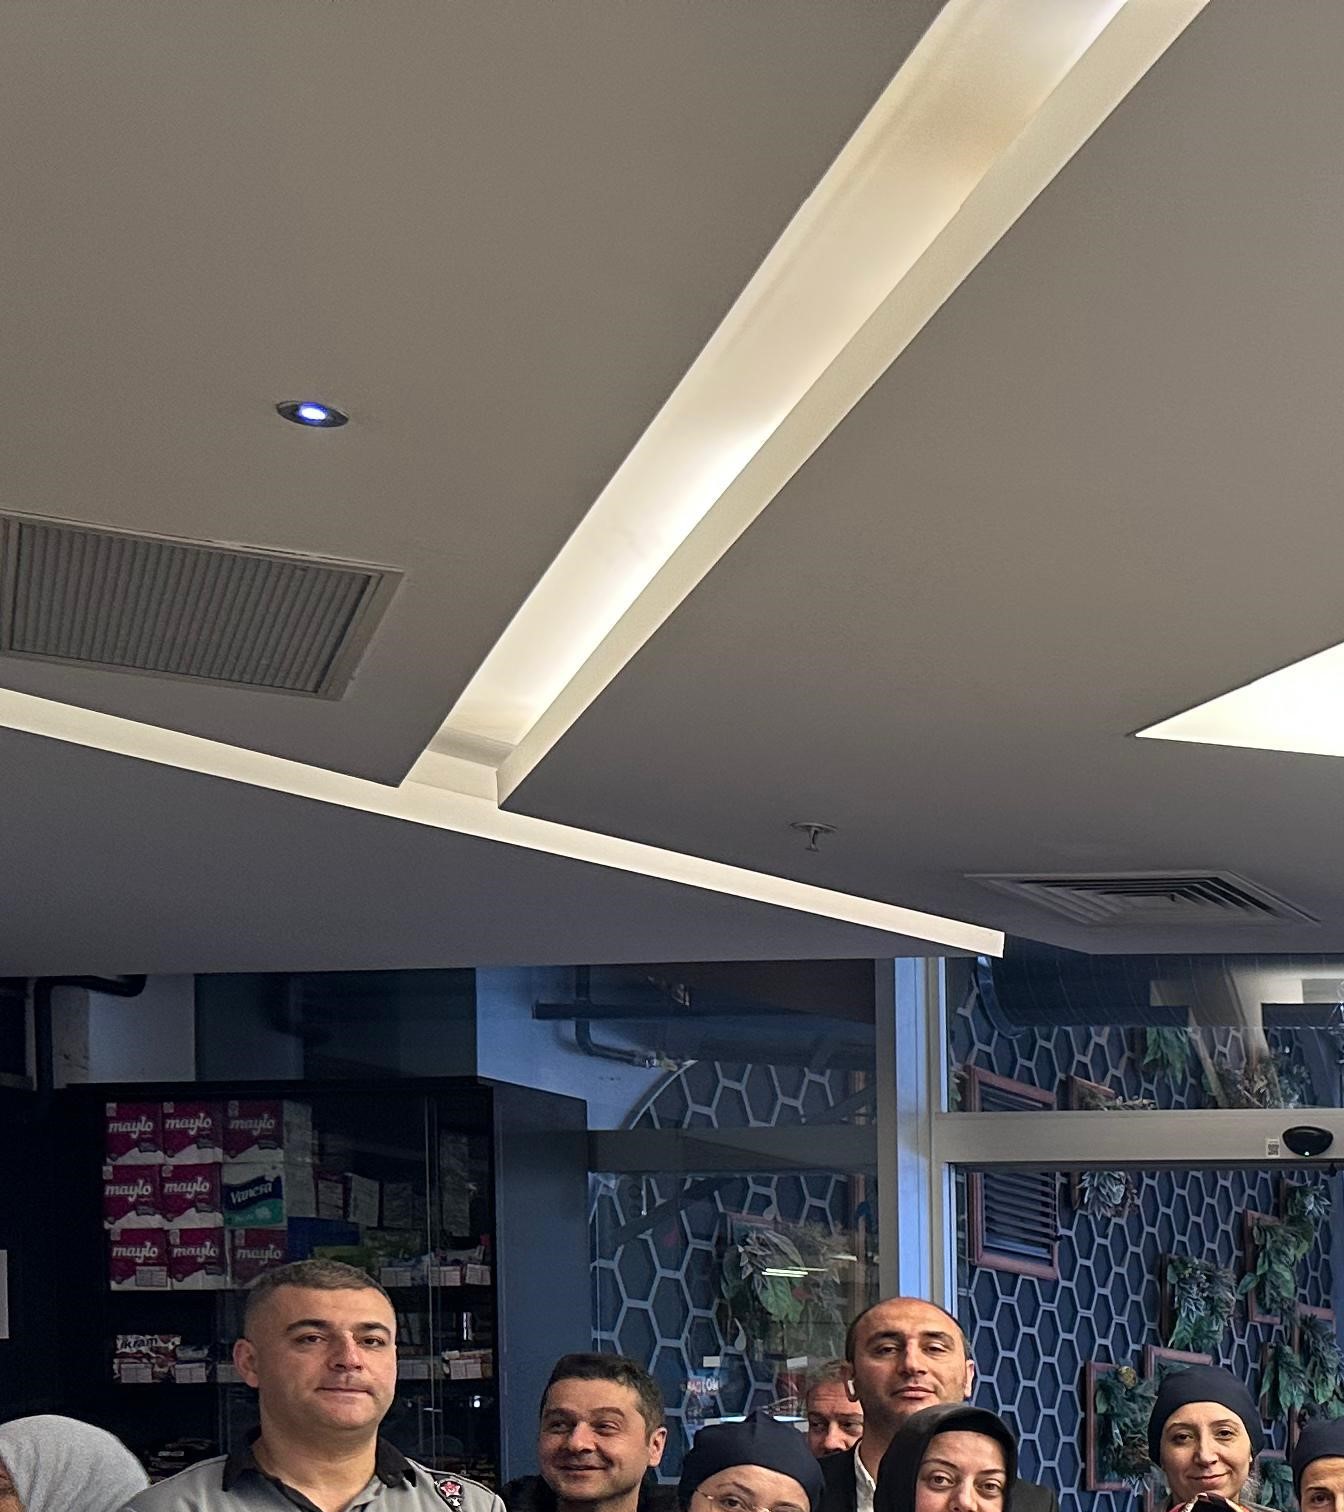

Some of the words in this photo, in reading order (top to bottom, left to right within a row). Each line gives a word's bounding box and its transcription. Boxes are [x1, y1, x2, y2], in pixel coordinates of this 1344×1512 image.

[108, 1116, 153, 1139] maylo
[165, 1113, 212, 1135] maylo
[230, 1113, 275, 1135] maylo
[105, 1179, 152, 1202] maylo
[163, 1176, 210, 1199] maylo
[112, 1241, 158, 1263] maylo
[172, 1241, 218, 1263] maylo
[237, 1244, 282, 1264] maylo
